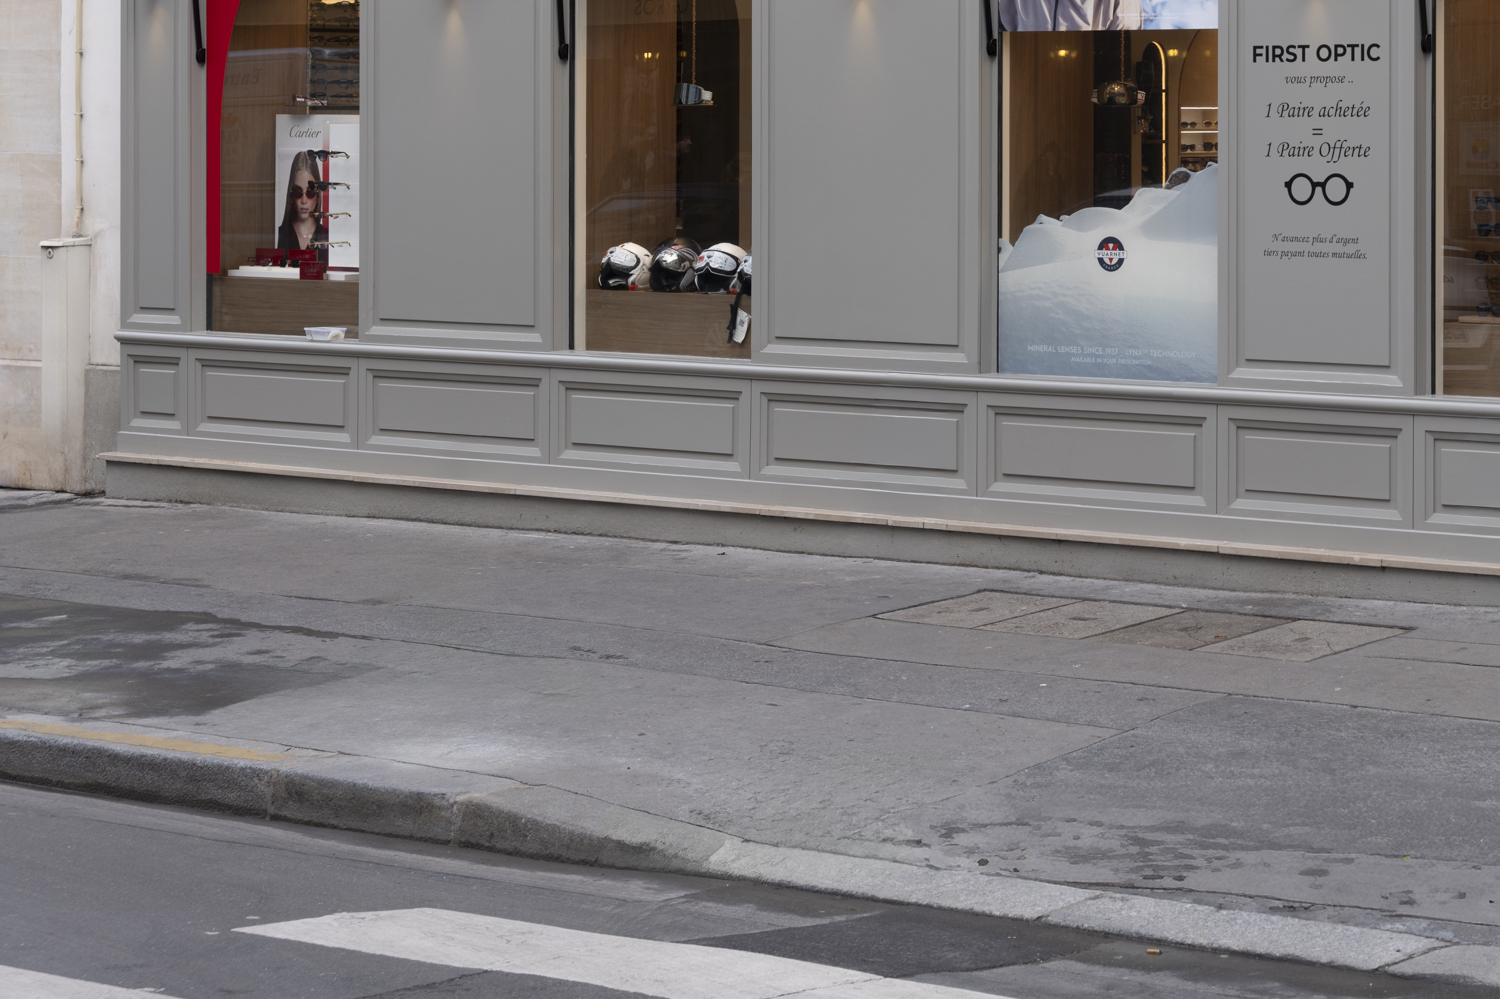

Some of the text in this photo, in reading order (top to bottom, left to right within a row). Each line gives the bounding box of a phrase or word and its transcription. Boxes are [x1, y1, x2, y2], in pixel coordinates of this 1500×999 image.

[1252, 43, 1381, 63] FIRST OPTIC
[1285, 75, 1307, 84] vous
[1309, 75, 1346, 87] propose
[1264, 100, 1371, 118] 1 Paire achetée
[289, 124, 322, 139] Cartier
[1264, 139, 1371, 164] 1 Paire Offerte
[1311, 233, 1328, 246] plus
[1329, 233, 1359, 247] d'argent
[1263, 248, 1368, 260] tiers payant toutes mutuelles.
[1027, 344, 1056, 352] MINERAL
[1057, 345, 1082, 354] LENSES
[1105, 347, 1119, 355] 1957
[1150, 349, 1197, 359] TECHNOLOGY
